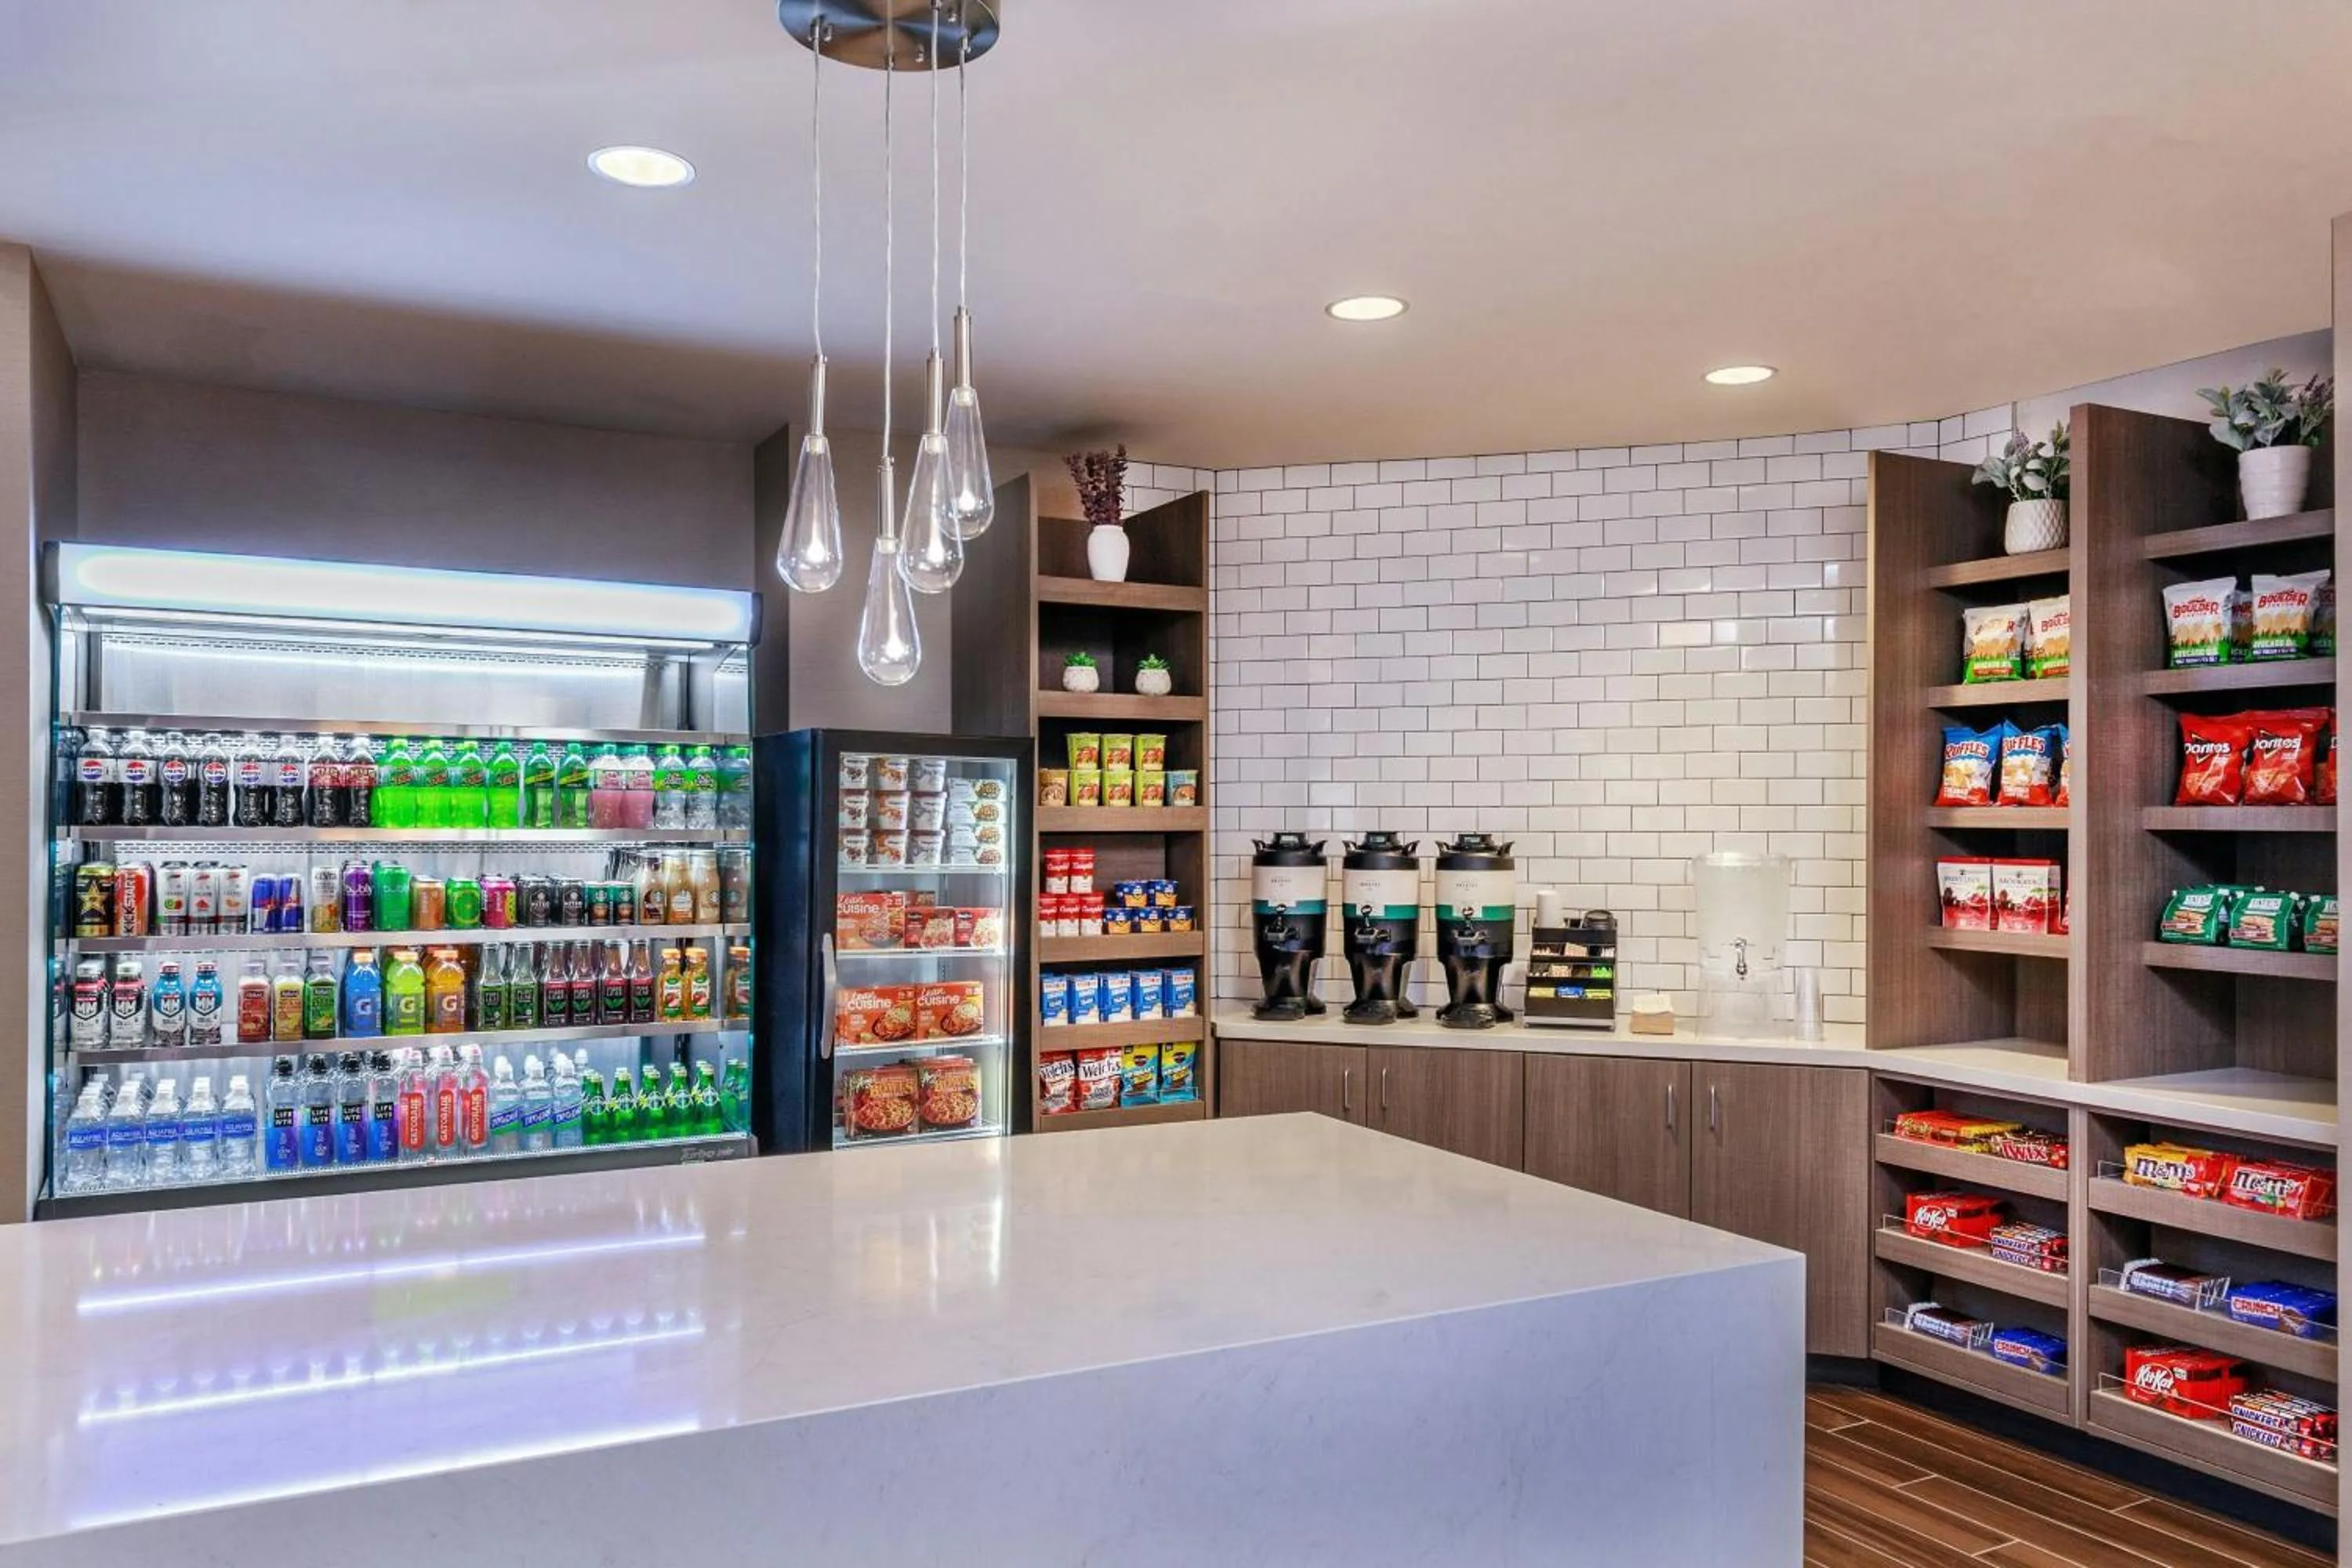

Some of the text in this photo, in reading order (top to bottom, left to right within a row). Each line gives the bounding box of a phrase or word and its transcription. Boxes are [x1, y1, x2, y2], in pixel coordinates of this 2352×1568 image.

[2258, 593, 2307, 608] BOULDER
[400, 997, 415, 1013] G
[442, 995, 457, 1011] G
[848, 999, 891, 1011] cuisine
[917, 995, 960, 1007] cuisine
[2234, 1406, 2278, 1428] SNICKERS
[2235, 1423, 2279, 1446] SNICKERS
